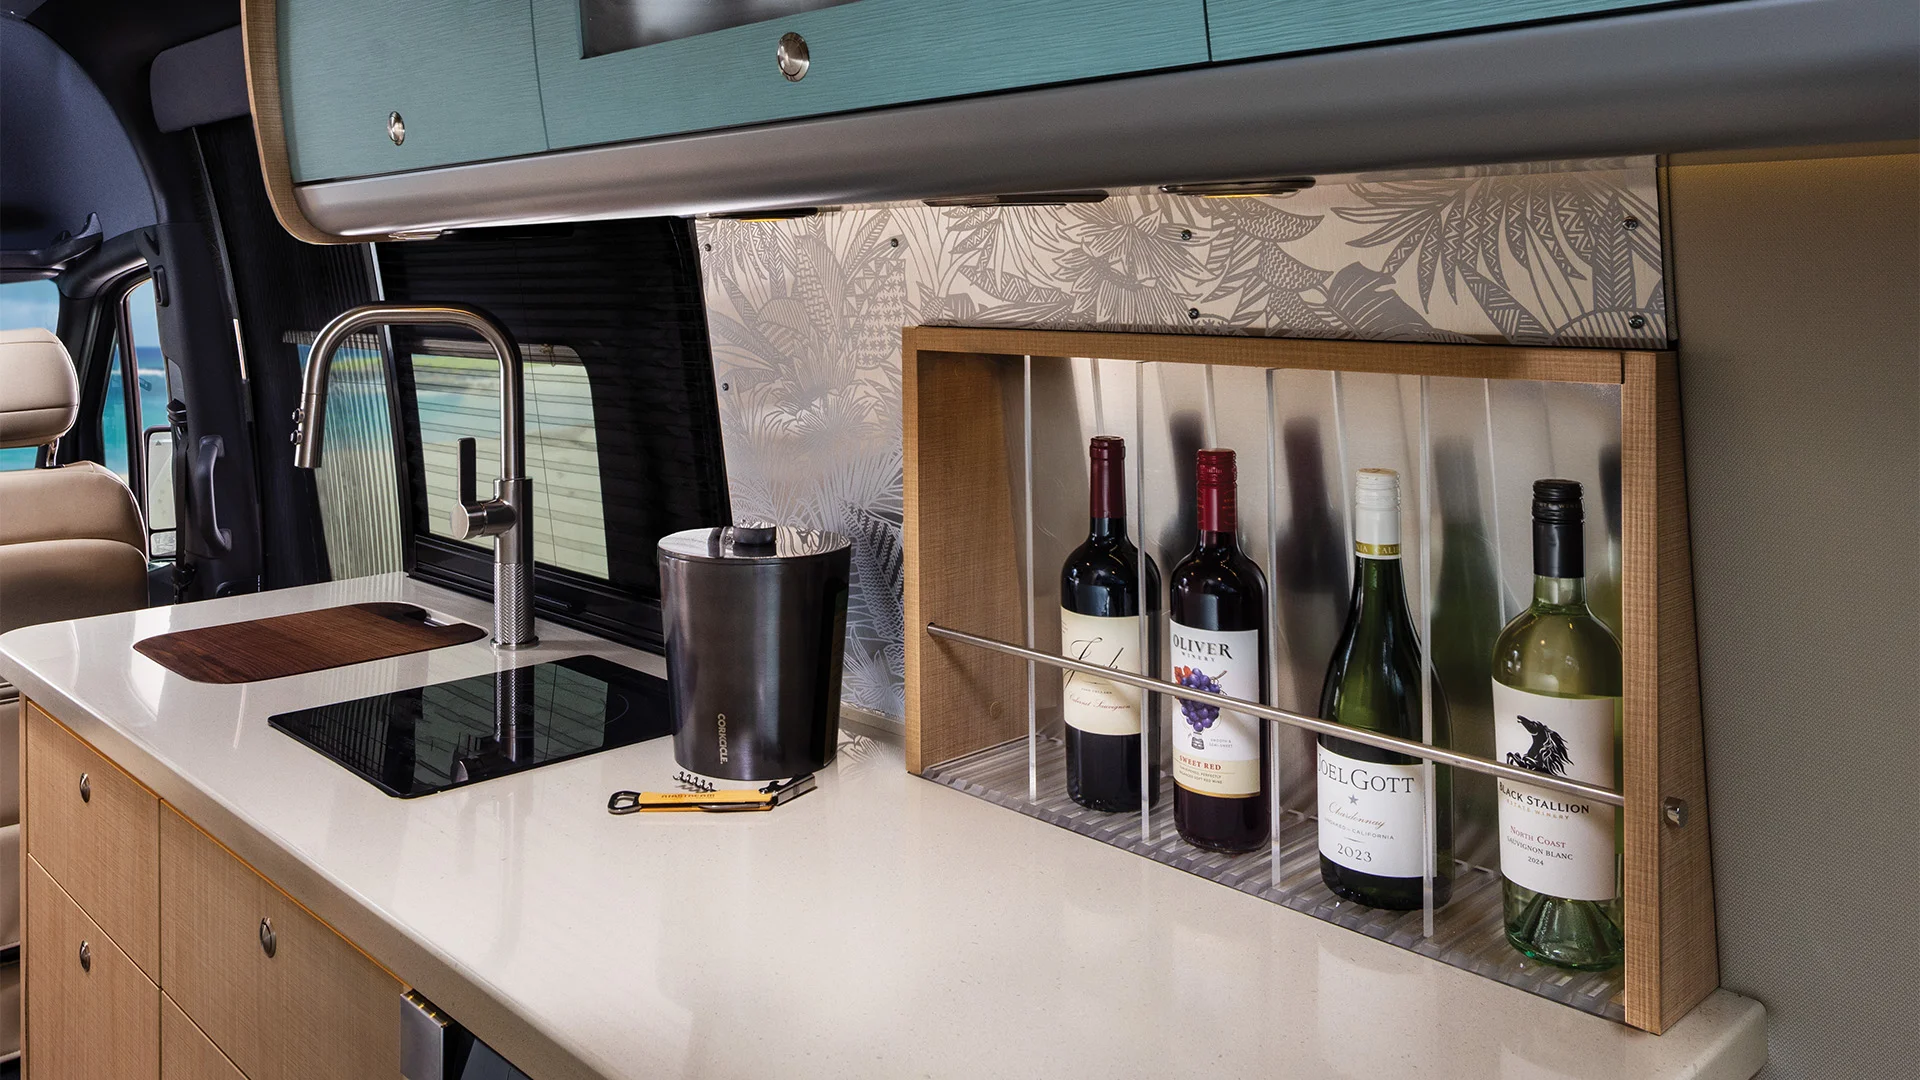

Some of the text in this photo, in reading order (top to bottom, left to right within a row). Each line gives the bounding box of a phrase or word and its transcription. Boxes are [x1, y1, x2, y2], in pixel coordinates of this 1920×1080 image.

[1172, 633, 1234, 660] OLIVER
[1180, 651, 1216, 663] WINERY
[1093, 699, 1131, 712] Sauvignon
[1179, 755, 1202, 768] SWEET
[1203, 762, 1222, 771] RED
[1318, 753, 1415, 793] JOEL GOTT
[1499, 781, 1590, 814] BLACK STALLION
[1328, 801, 1387, 830] Chardonnay
[1534, 809, 1570, 820] WINERY
[1352, 828, 1395, 841] CALIFORNIA
[1510, 825, 1567, 849] NORTH COAST
[1337, 843, 1373, 863] 2023
[1507, 835, 1574, 861] SAUVIGNON BLANC
[1527, 856, 1545, 867] 2024
